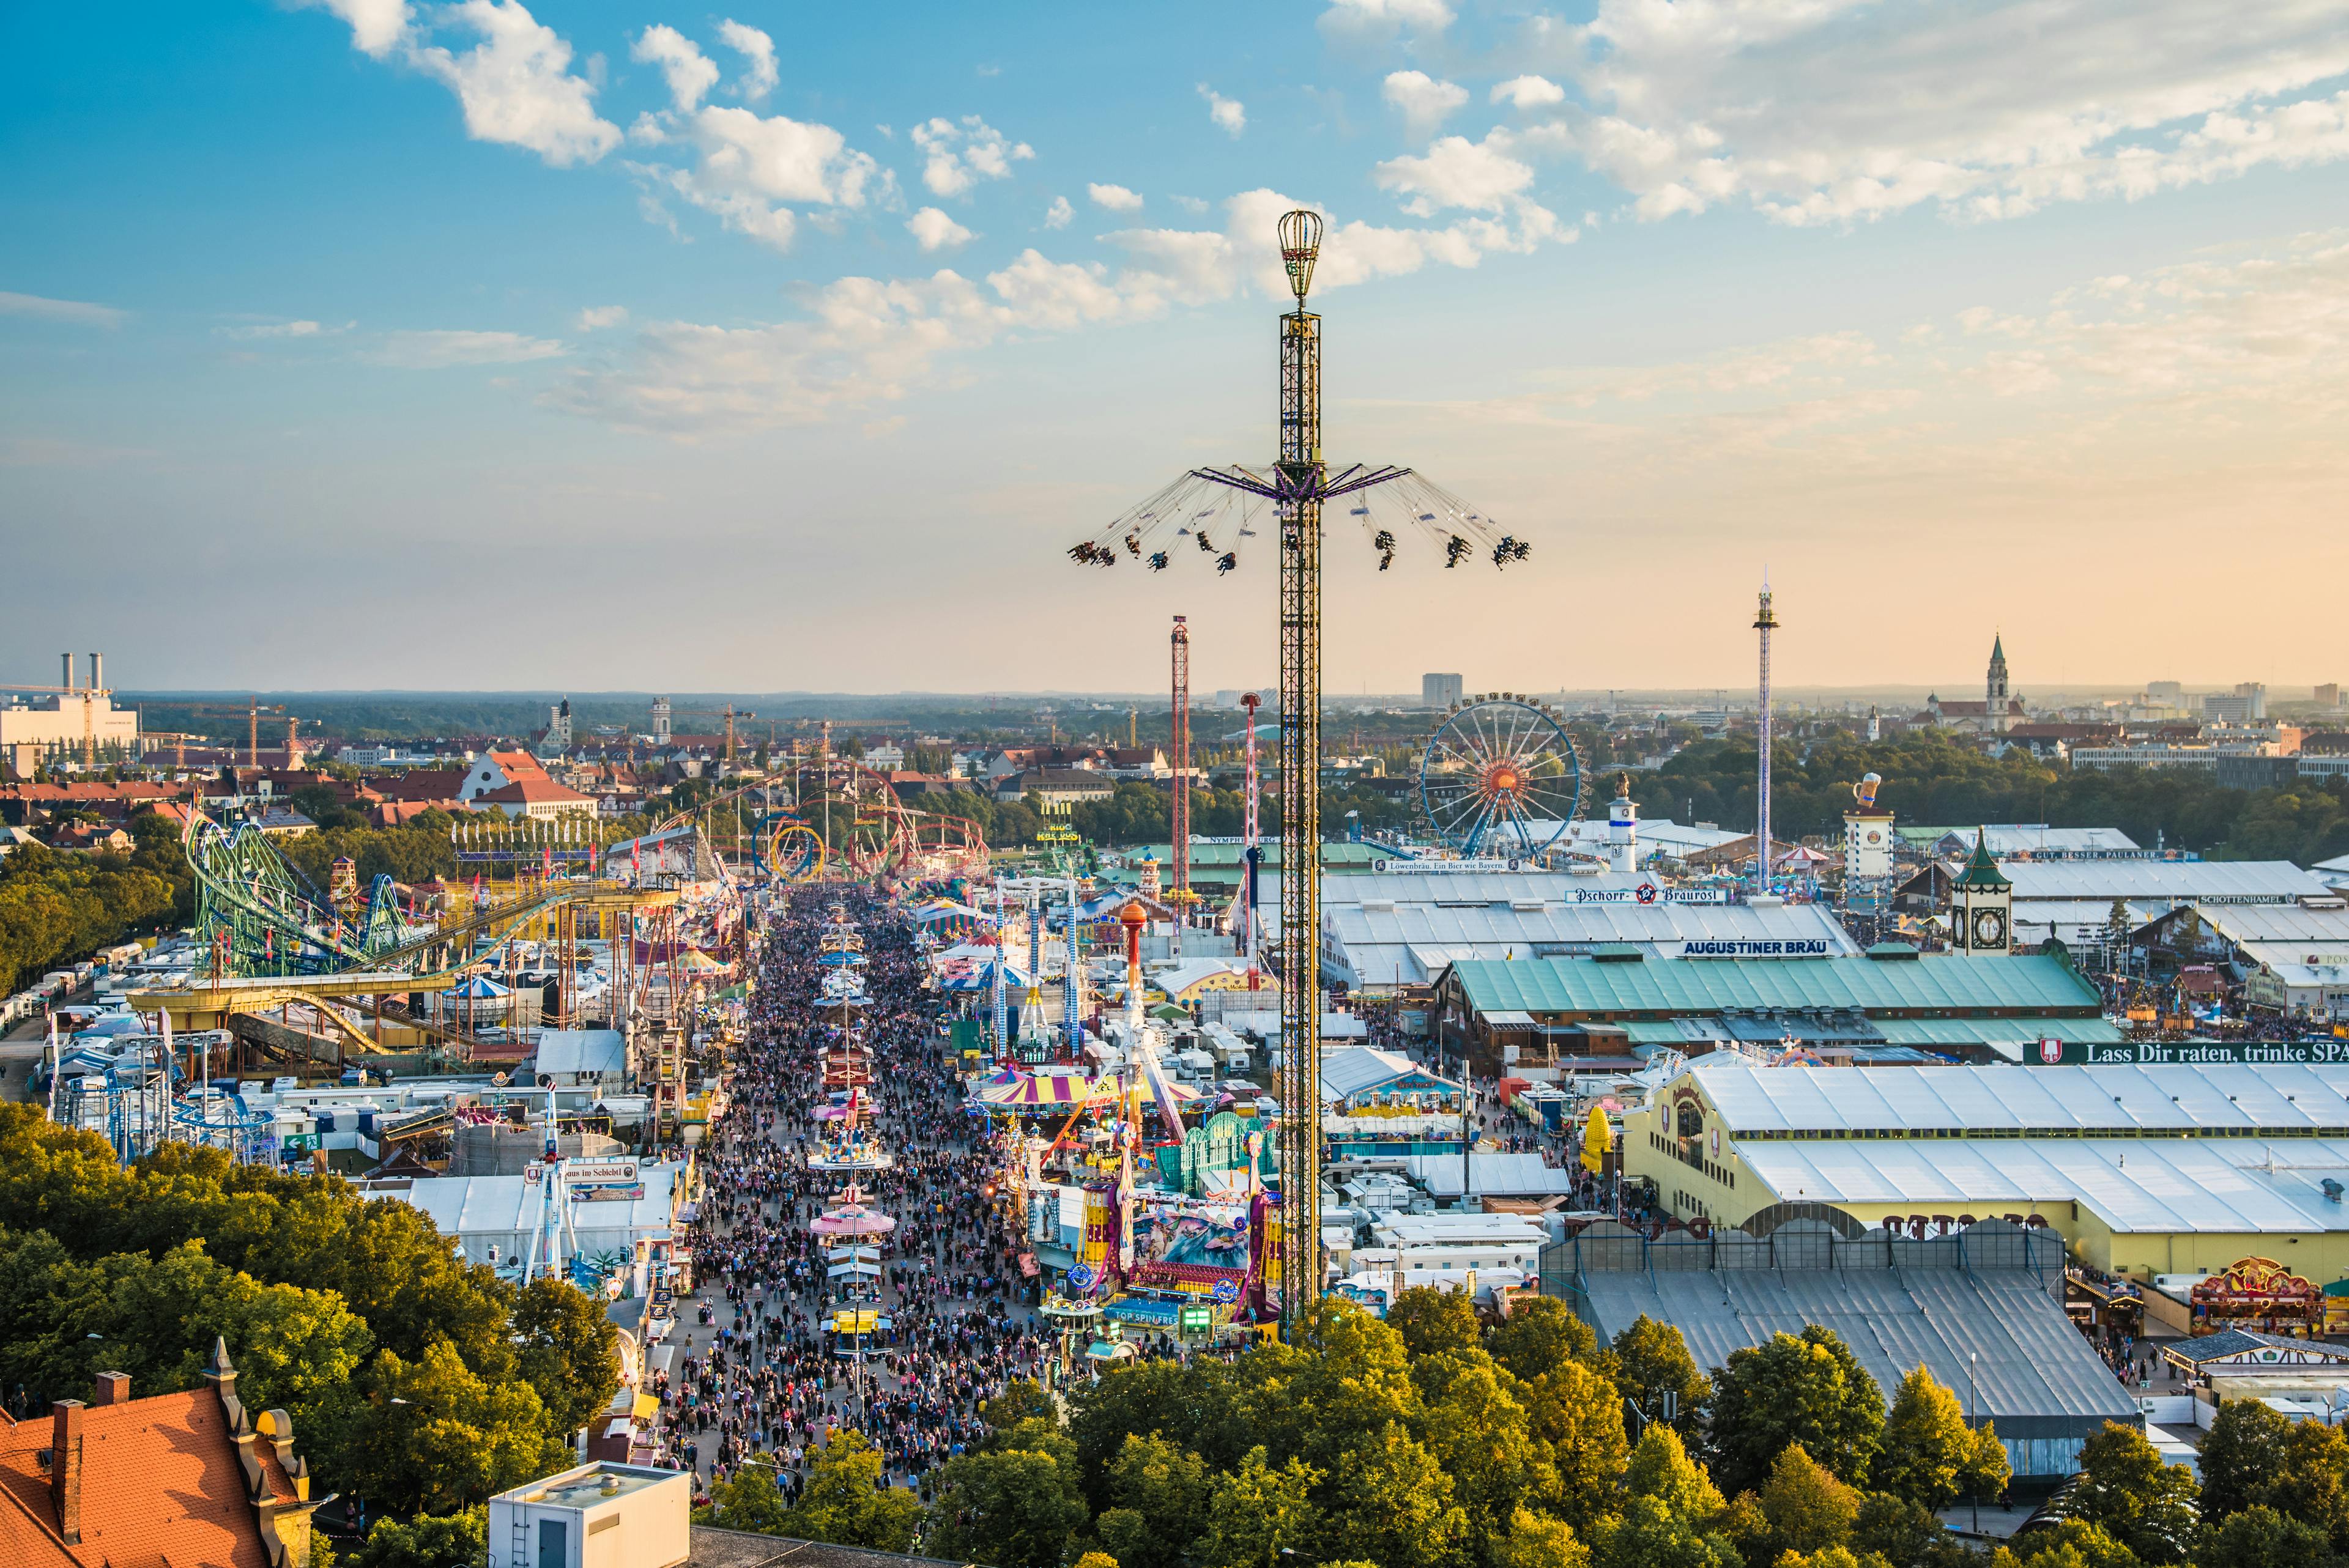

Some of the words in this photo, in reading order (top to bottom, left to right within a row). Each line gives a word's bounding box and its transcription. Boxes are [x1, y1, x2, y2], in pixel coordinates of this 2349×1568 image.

[1478, 862, 1505, 871] Bayern.
[1575, 888, 1630, 904] Pschorr-
[1684, 942, 1783, 954] AUGUSTINER
[1786, 939, 1827, 953] BRÄU
[2086, 1044, 2132, 1062] Lass
[2137, 1043, 2173, 1062] Dir
[2178, 1045, 2238, 1063] raten,
[2244, 1043, 2306, 1062] trinke
[582, 1169, 592, 1178] im
[593, 1168, 622, 1178] Schichtl
[1115, 1311, 1133, 1321] TOP
[1135, 1314, 1156, 1324] SPIN
[1158, 1315, 1179, 1325] FRES
